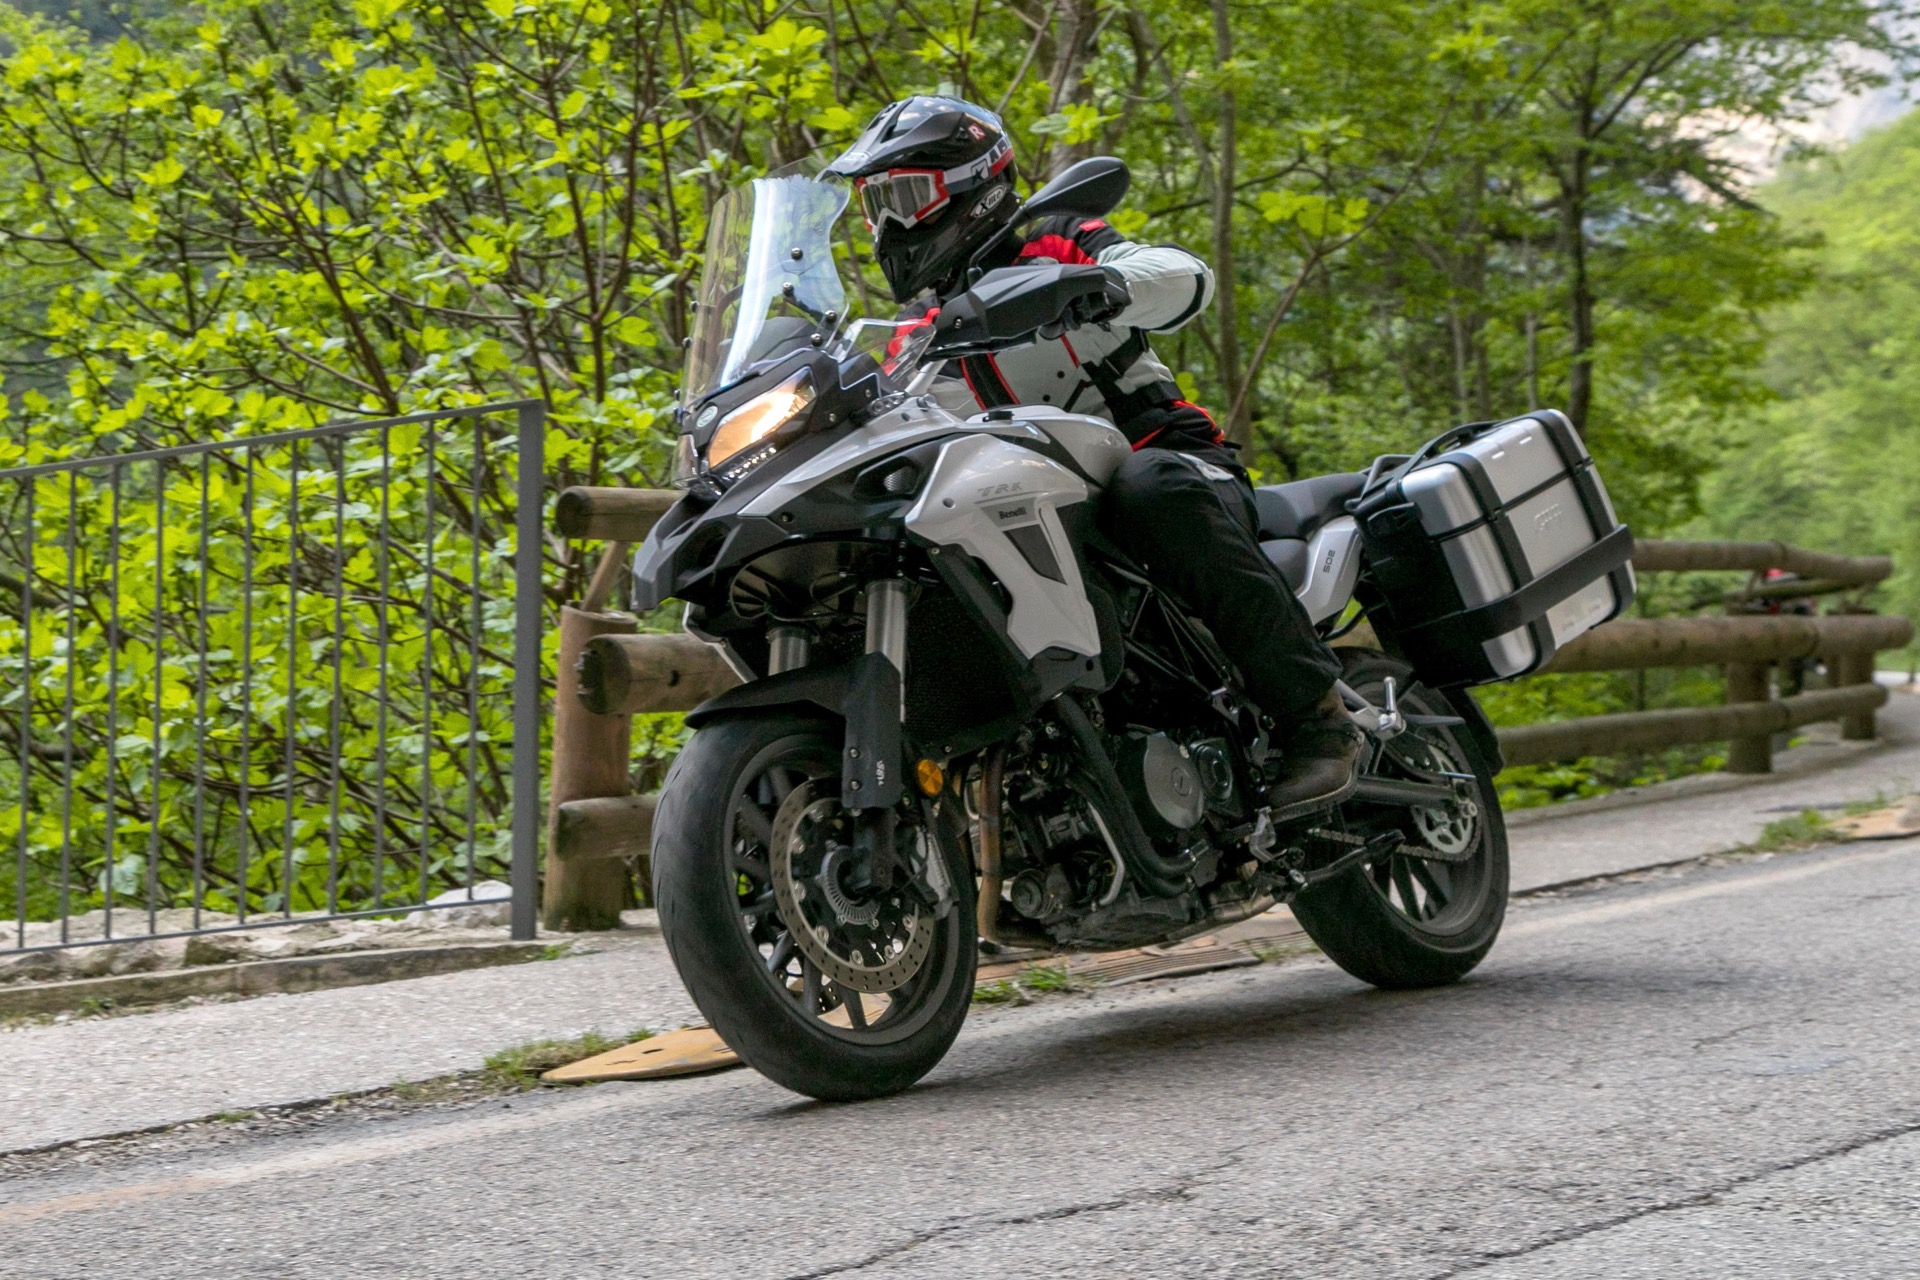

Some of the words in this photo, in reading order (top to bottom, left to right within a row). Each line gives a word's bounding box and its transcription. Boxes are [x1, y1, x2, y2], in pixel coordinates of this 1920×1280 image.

[977, 482, 1022, 497] TRK
[998, 506, 1027, 520] Benelli
[1322, 549, 1336, 574] 502
